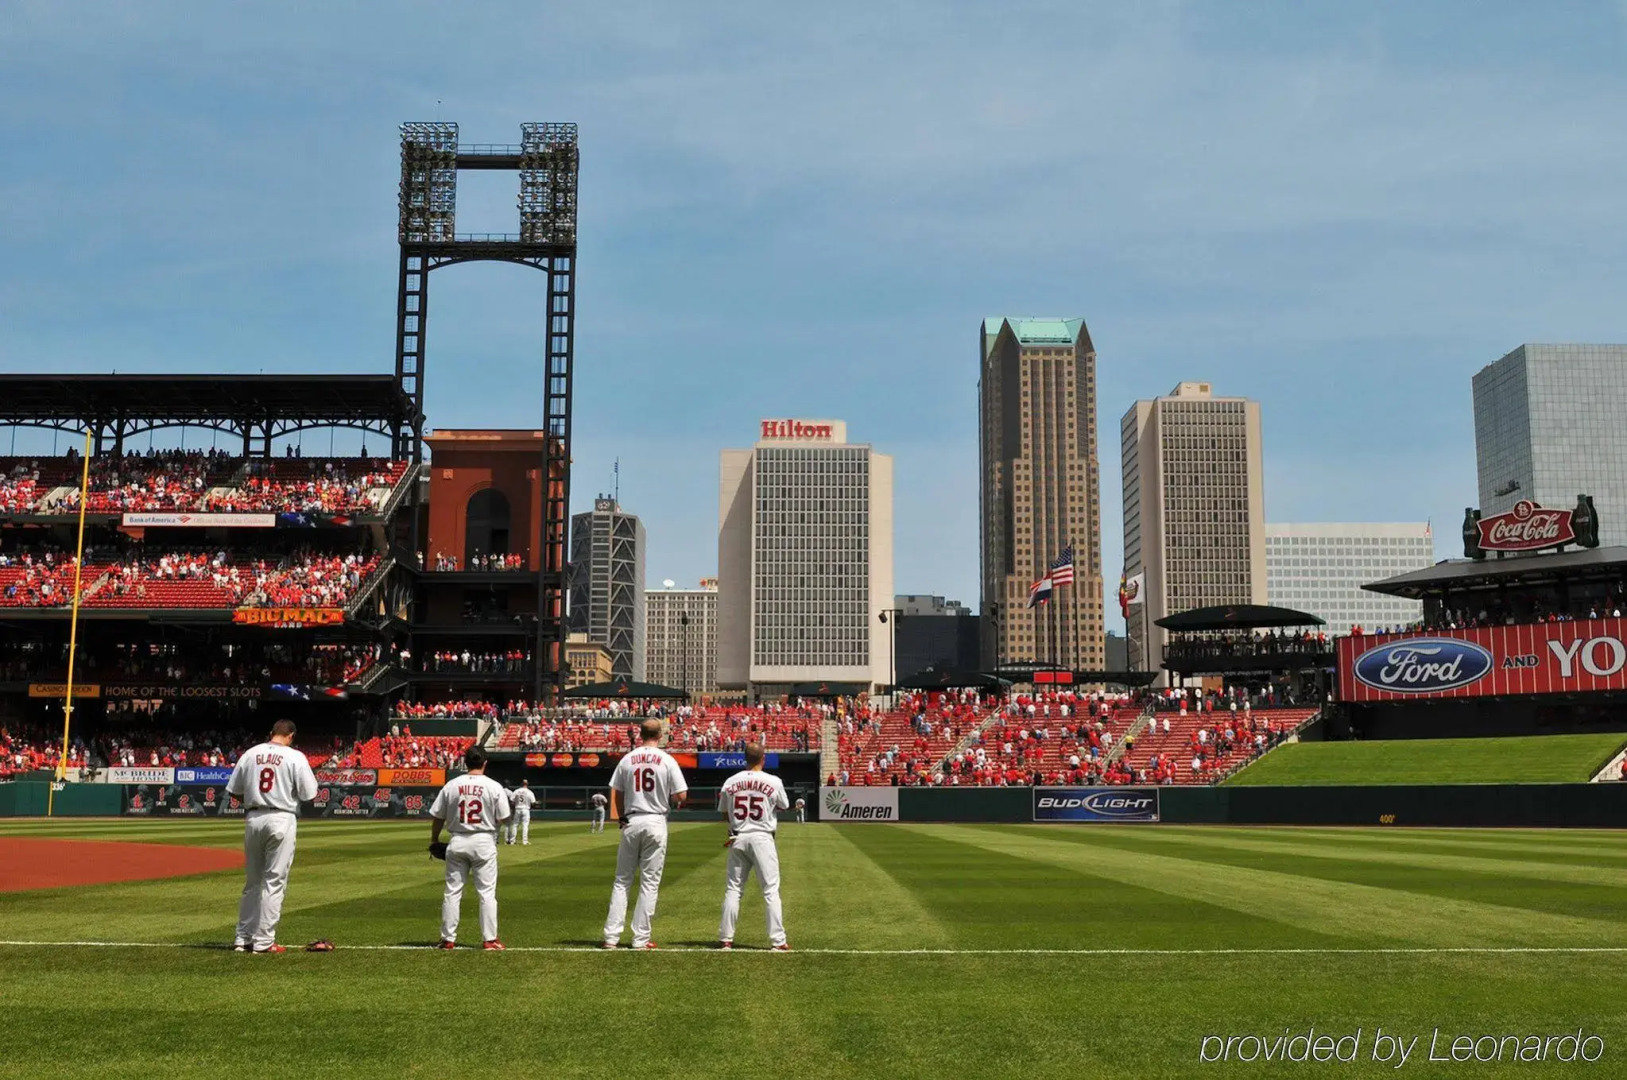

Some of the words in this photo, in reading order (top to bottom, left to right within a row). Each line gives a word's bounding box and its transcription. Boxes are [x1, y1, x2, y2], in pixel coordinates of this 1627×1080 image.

[761, 419, 832, 438] Hilton
[129, 516, 144, 524] Bank
[145, 516, 151, 524] of
[151, 516, 176, 524] America
[1489, 512, 1562, 544] Coca-Cola
[247, 609, 281, 623] BIG
[283, 609, 330, 624] MAC
[1380, 646, 1464, 684] Ford
[1502, 654, 1540, 669] AND
[1546, 636, 1627, 677] YO
[105, 686, 138, 697] HOME
[140, 686, 155, 697] OF
[158, 686, 178, 697] THE
[181, 687, 228, 697] LOOSEST
[230, 687, 261, 697] SLOTS
[256, 753, 284, 766] GLAUS
[631, 753, 663, 766] DUNCAN
[726, 758, 737, 766] US
[259, 767, 275, 794] 8
[349, 770, 374, 783] Save
[393, 771, 433, 780] DOBBS
[633, 767, 656, 793] 16
[158, 786, 166, 801] 1
[205, 787, 216, 802] 6
[373, 788, 392, 802] 45
[458, 785, 485, 796] MILES
[725, 780, 775, 798] SCHUMAKER
[179, 794, 189, 808] 2
[342, 795, 360, 809] 42
[405, 795, 423, 809] 85
[733, 795, 765, 821] 55
[1038, 797, 1082, 808] BUD
[1092, 798, 1153, 808] LIGHT
[458, 799, 483, 824] 12
[841, 803, 892, 818] Ameren
